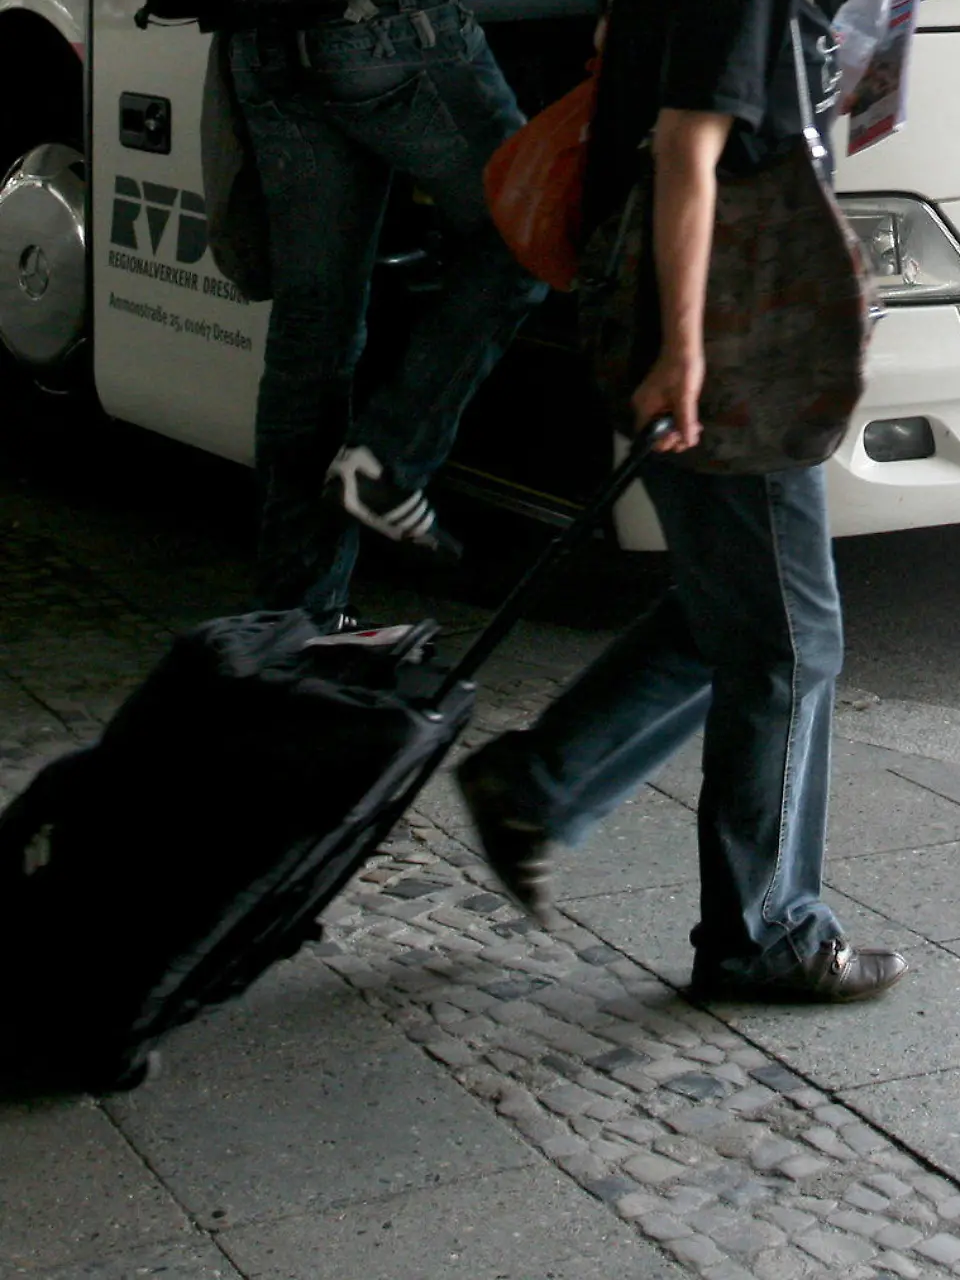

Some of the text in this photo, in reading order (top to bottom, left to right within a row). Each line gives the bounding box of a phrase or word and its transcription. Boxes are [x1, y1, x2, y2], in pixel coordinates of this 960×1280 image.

[110, 175, 209, 265] RVD
[108, 250, 199, 292] REGIONALVERKEHR
[212, 322, 253, 352] Dresden
